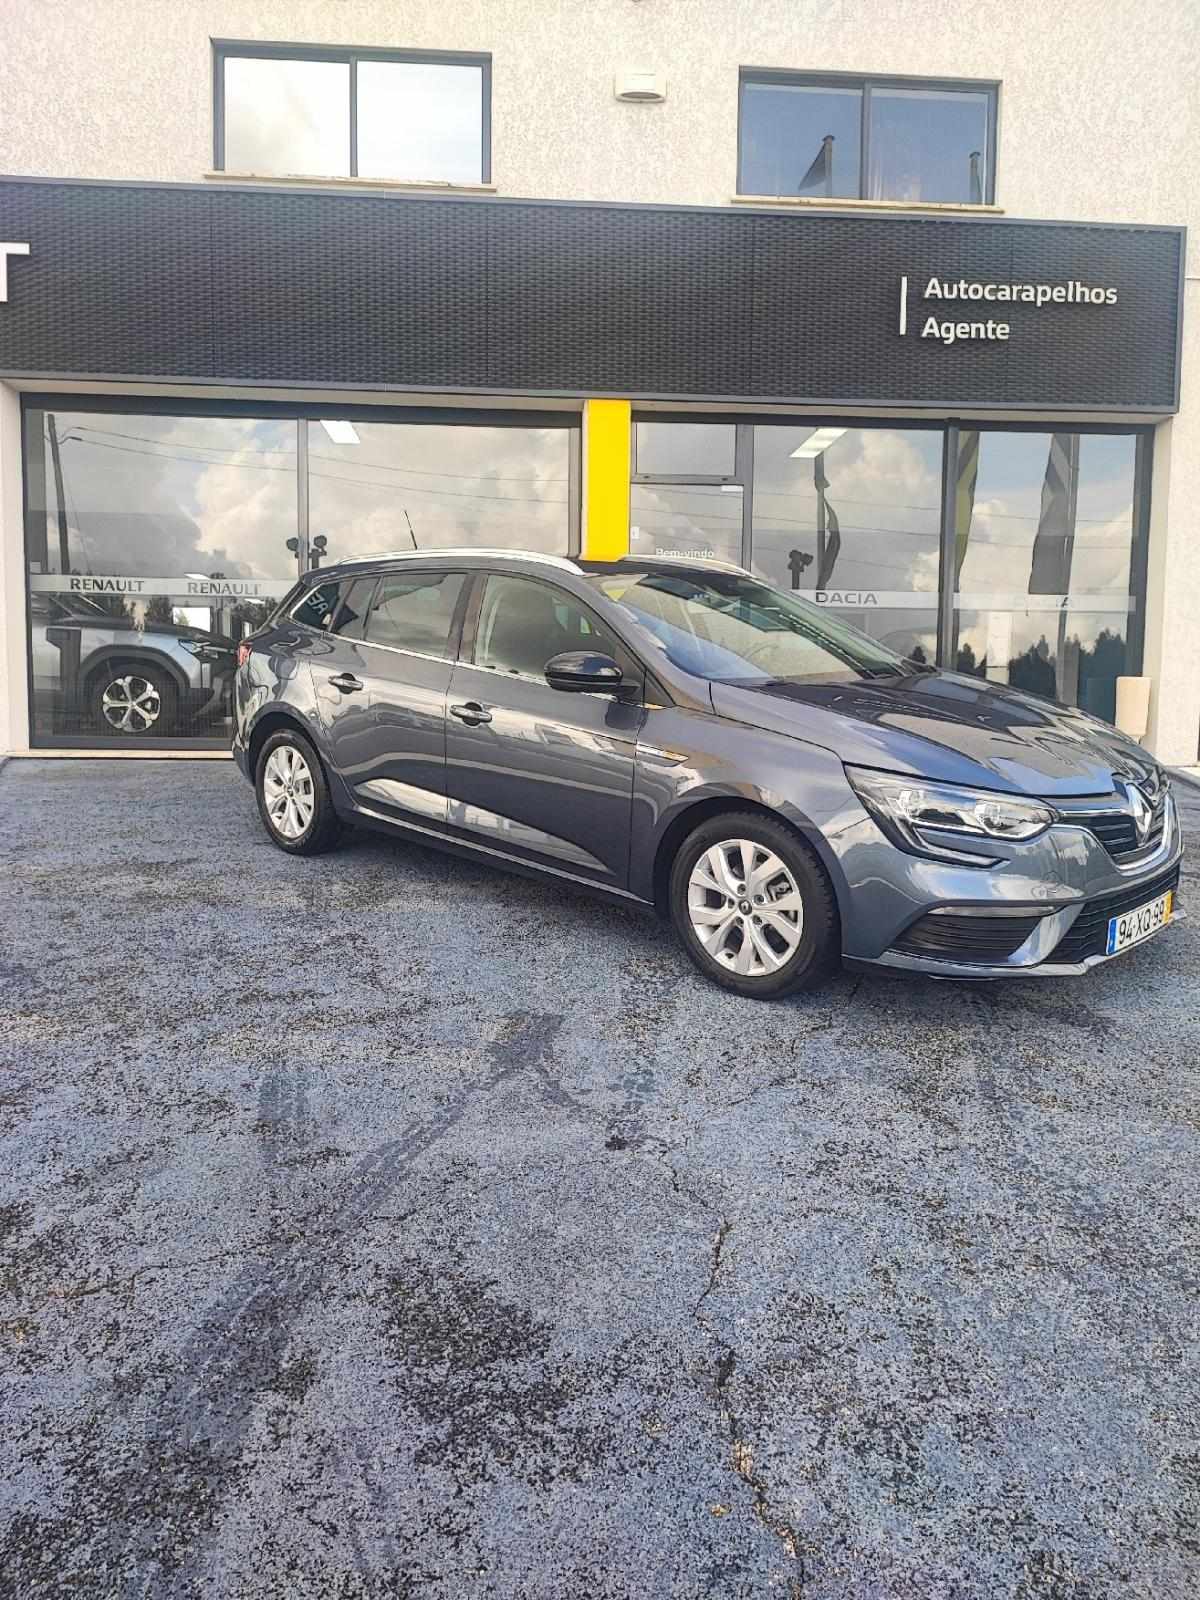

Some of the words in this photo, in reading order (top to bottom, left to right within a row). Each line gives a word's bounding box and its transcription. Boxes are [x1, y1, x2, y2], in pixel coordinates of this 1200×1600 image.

[923, 277, 1118, 306] Autocarapelhos
[921, 316, 1010, 344] Agente
[656, 548, 715, 559] Bem-vindo
[70, 577, 145, 592] RENAULT
[187, 582, 262, 595] RENAULT
[815, 591, 878, 605] DACIA
